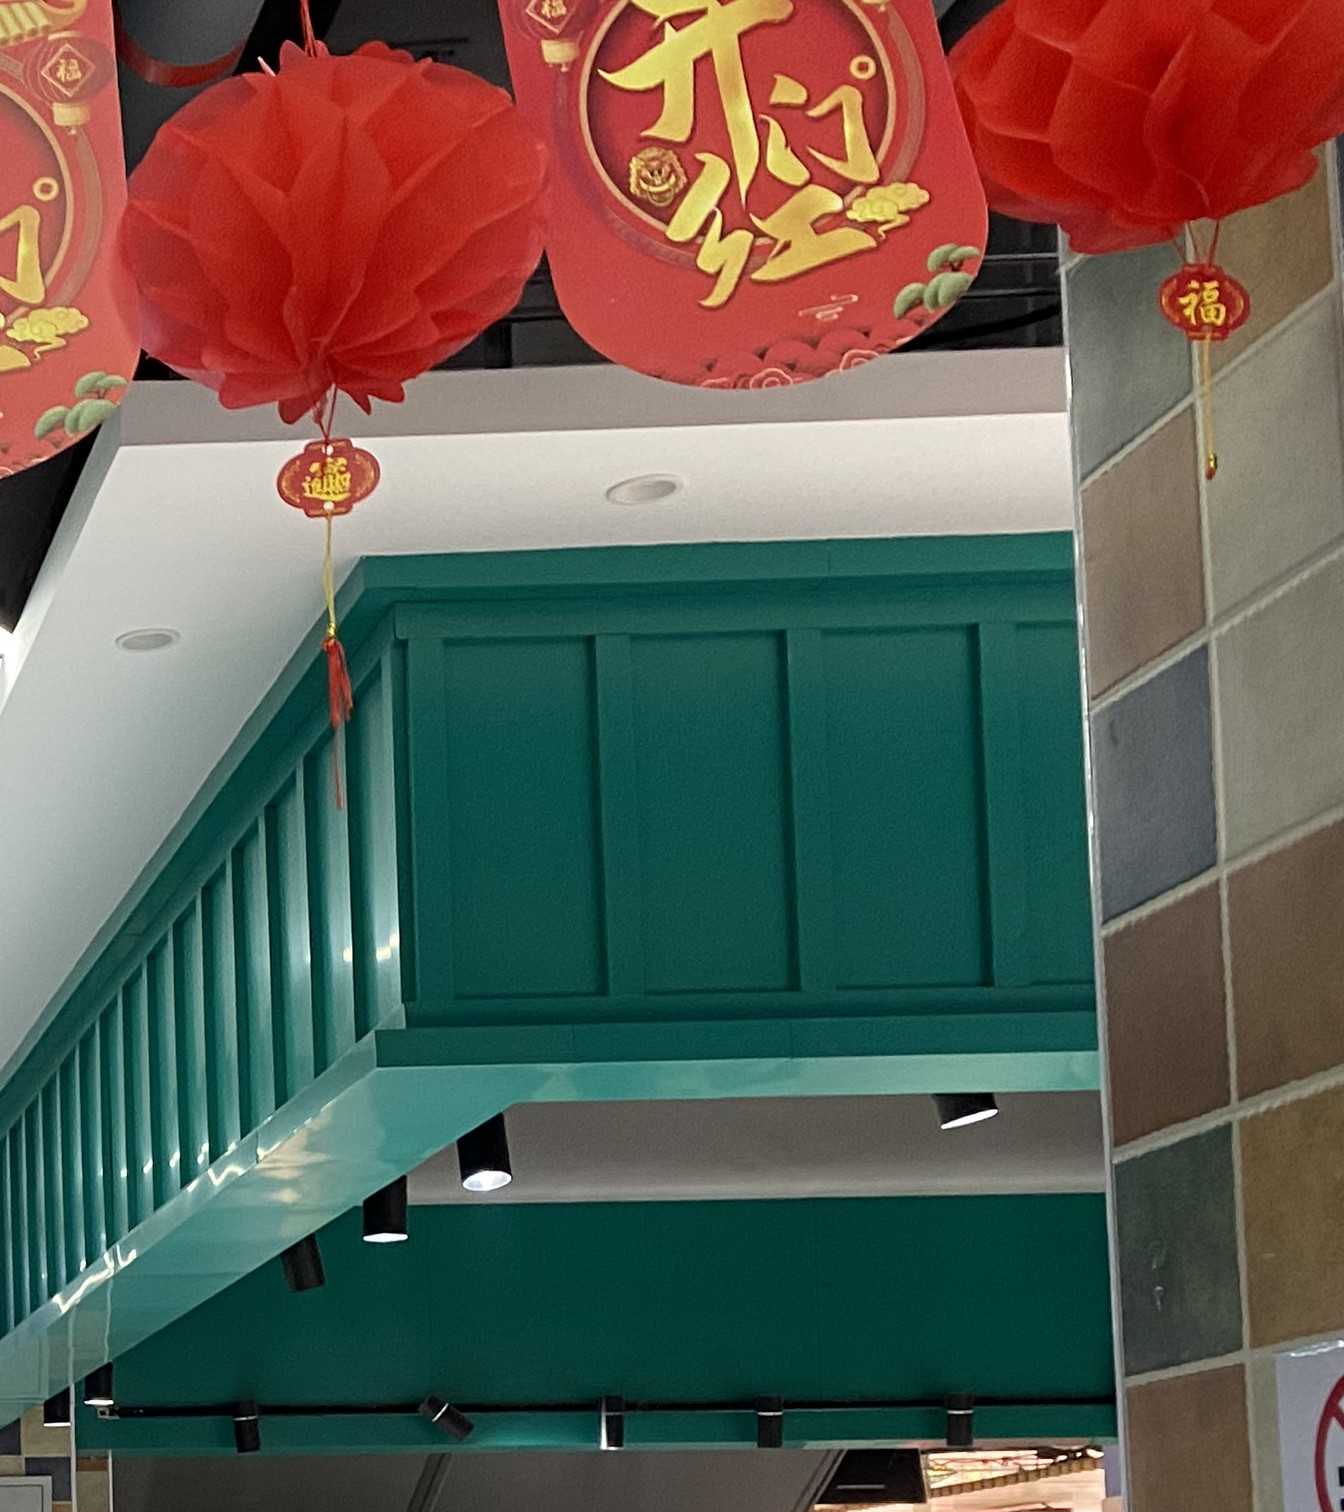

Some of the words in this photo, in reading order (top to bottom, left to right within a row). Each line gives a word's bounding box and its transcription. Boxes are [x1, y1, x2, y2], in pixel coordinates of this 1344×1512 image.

[599, 0, 883, 309] 开门红
[1178, 279, 1226, 326] 福
